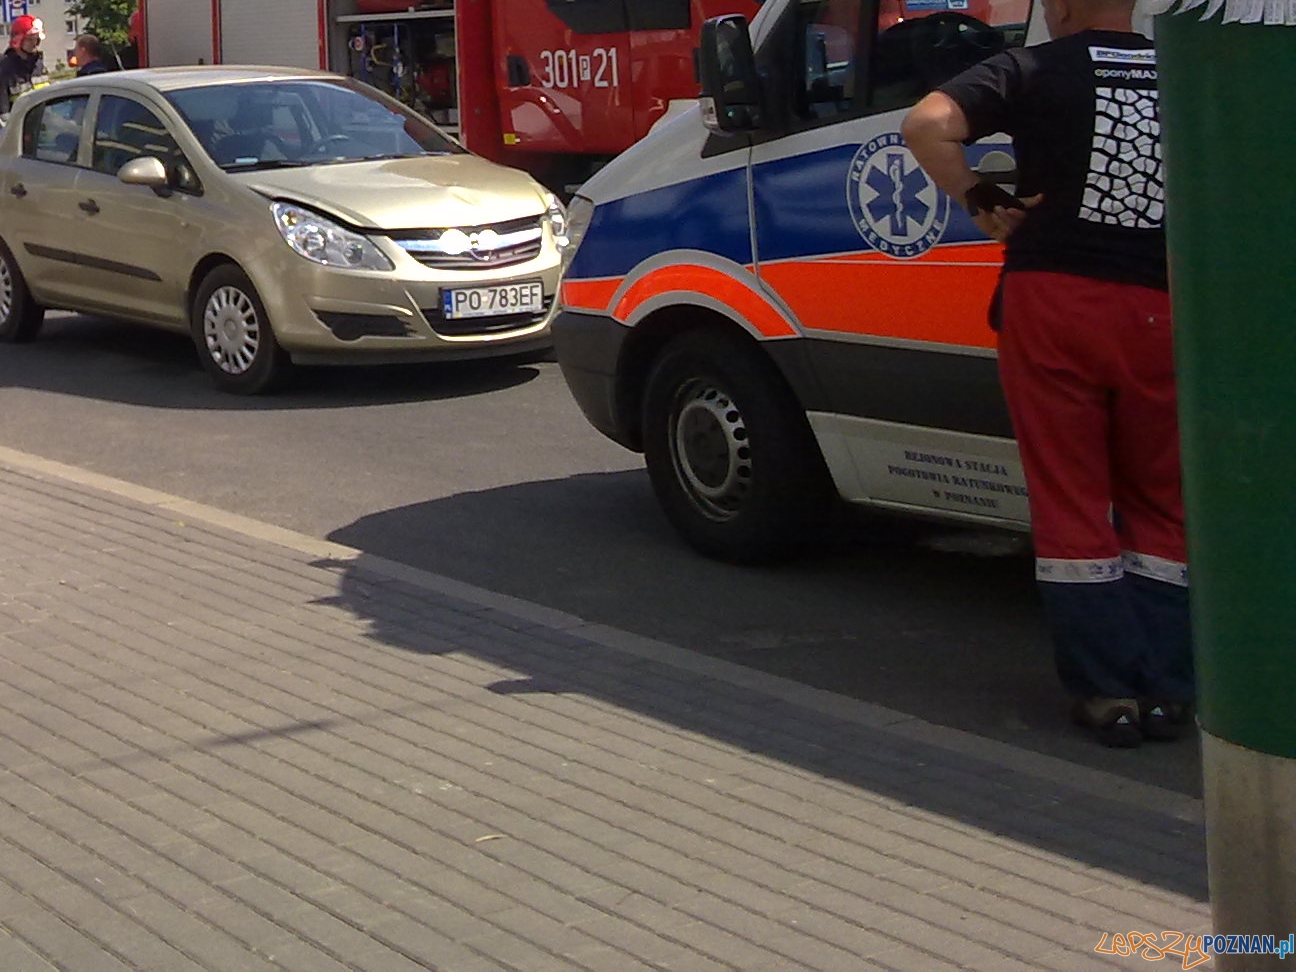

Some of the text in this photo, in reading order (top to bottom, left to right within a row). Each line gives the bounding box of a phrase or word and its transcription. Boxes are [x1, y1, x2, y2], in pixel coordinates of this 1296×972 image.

[851, 134, 906, 182] RATOWN
[455, 290, 481, 312] PO
[488, 284, 539, 309] 783EF
[952, 476, 1029, 497] RATUNKOWEG
